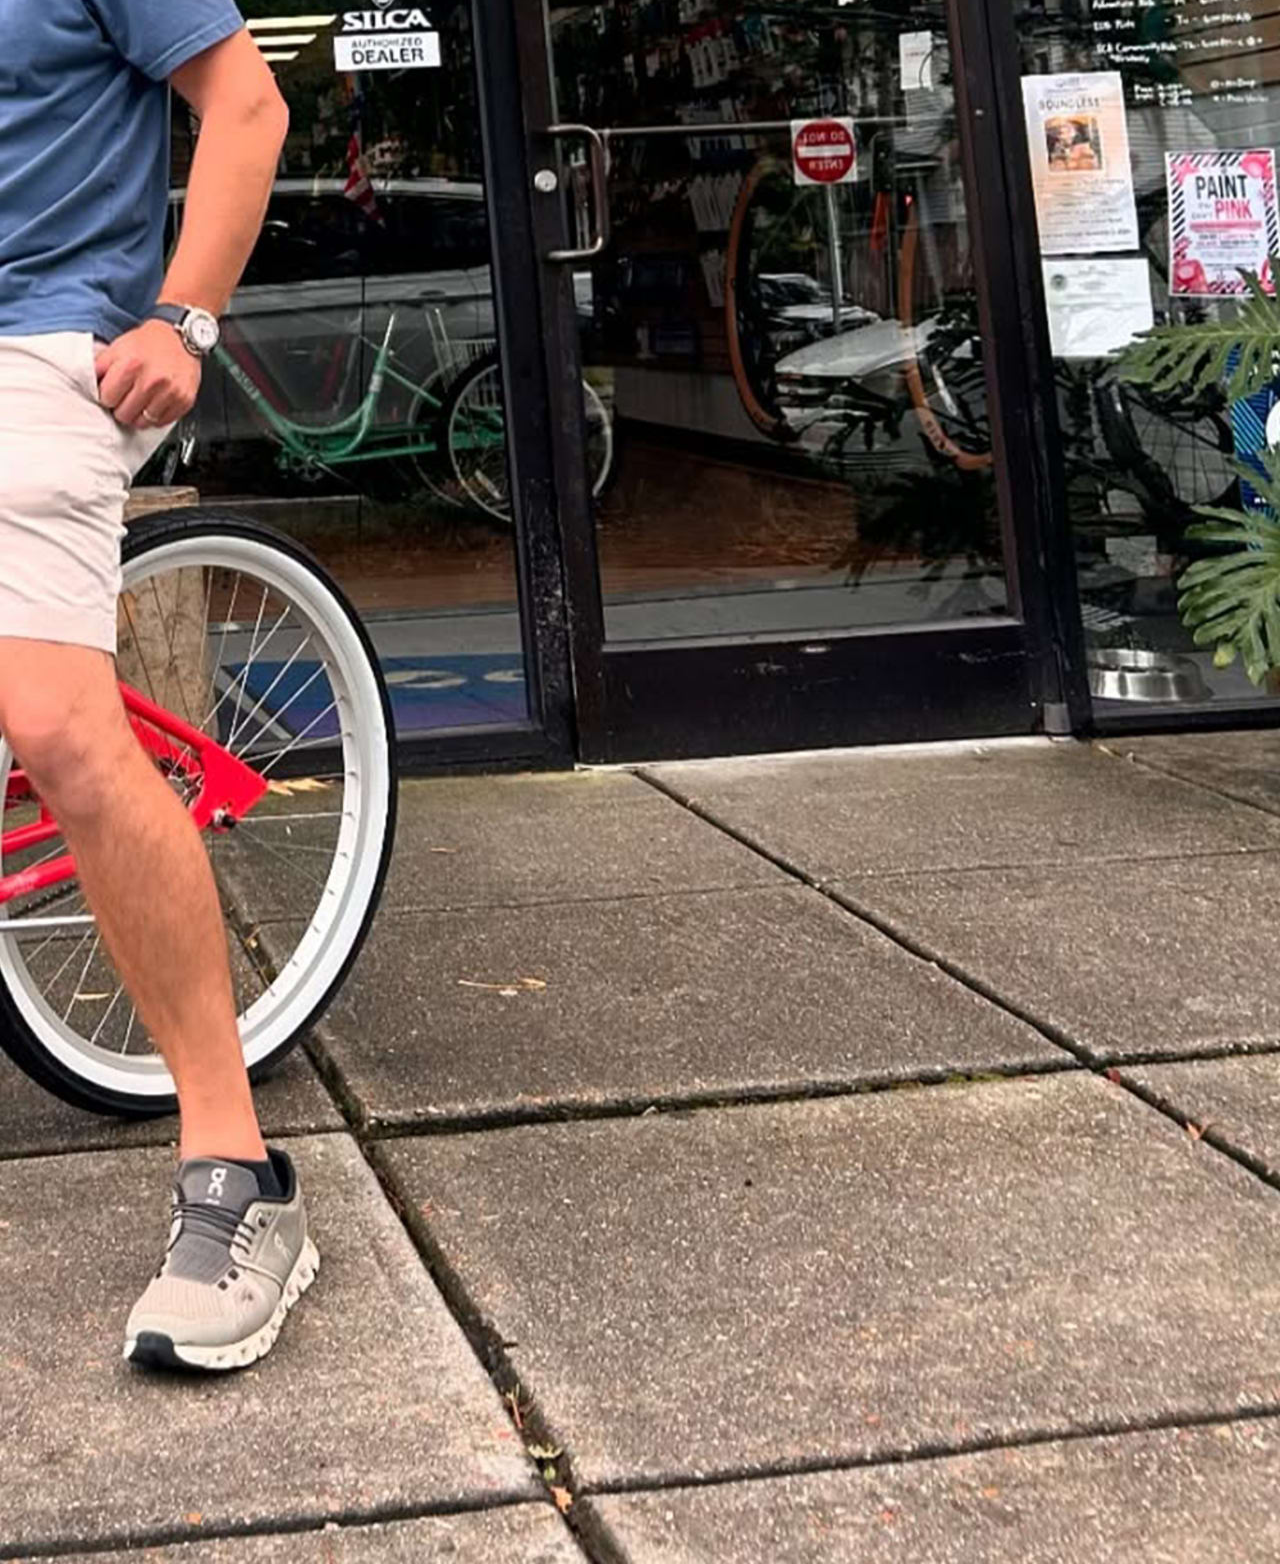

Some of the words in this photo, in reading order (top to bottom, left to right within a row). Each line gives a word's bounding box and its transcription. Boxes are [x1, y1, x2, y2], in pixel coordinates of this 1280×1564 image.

[341, 8, 432, 31] SILCA
[351, 37, 423, 48] AUTHORIZED
[351, 46, 424, 66] DEALER
[1195, 175, 1247, 199] PAINT
[1214, 199, 1253, 219] PINK
